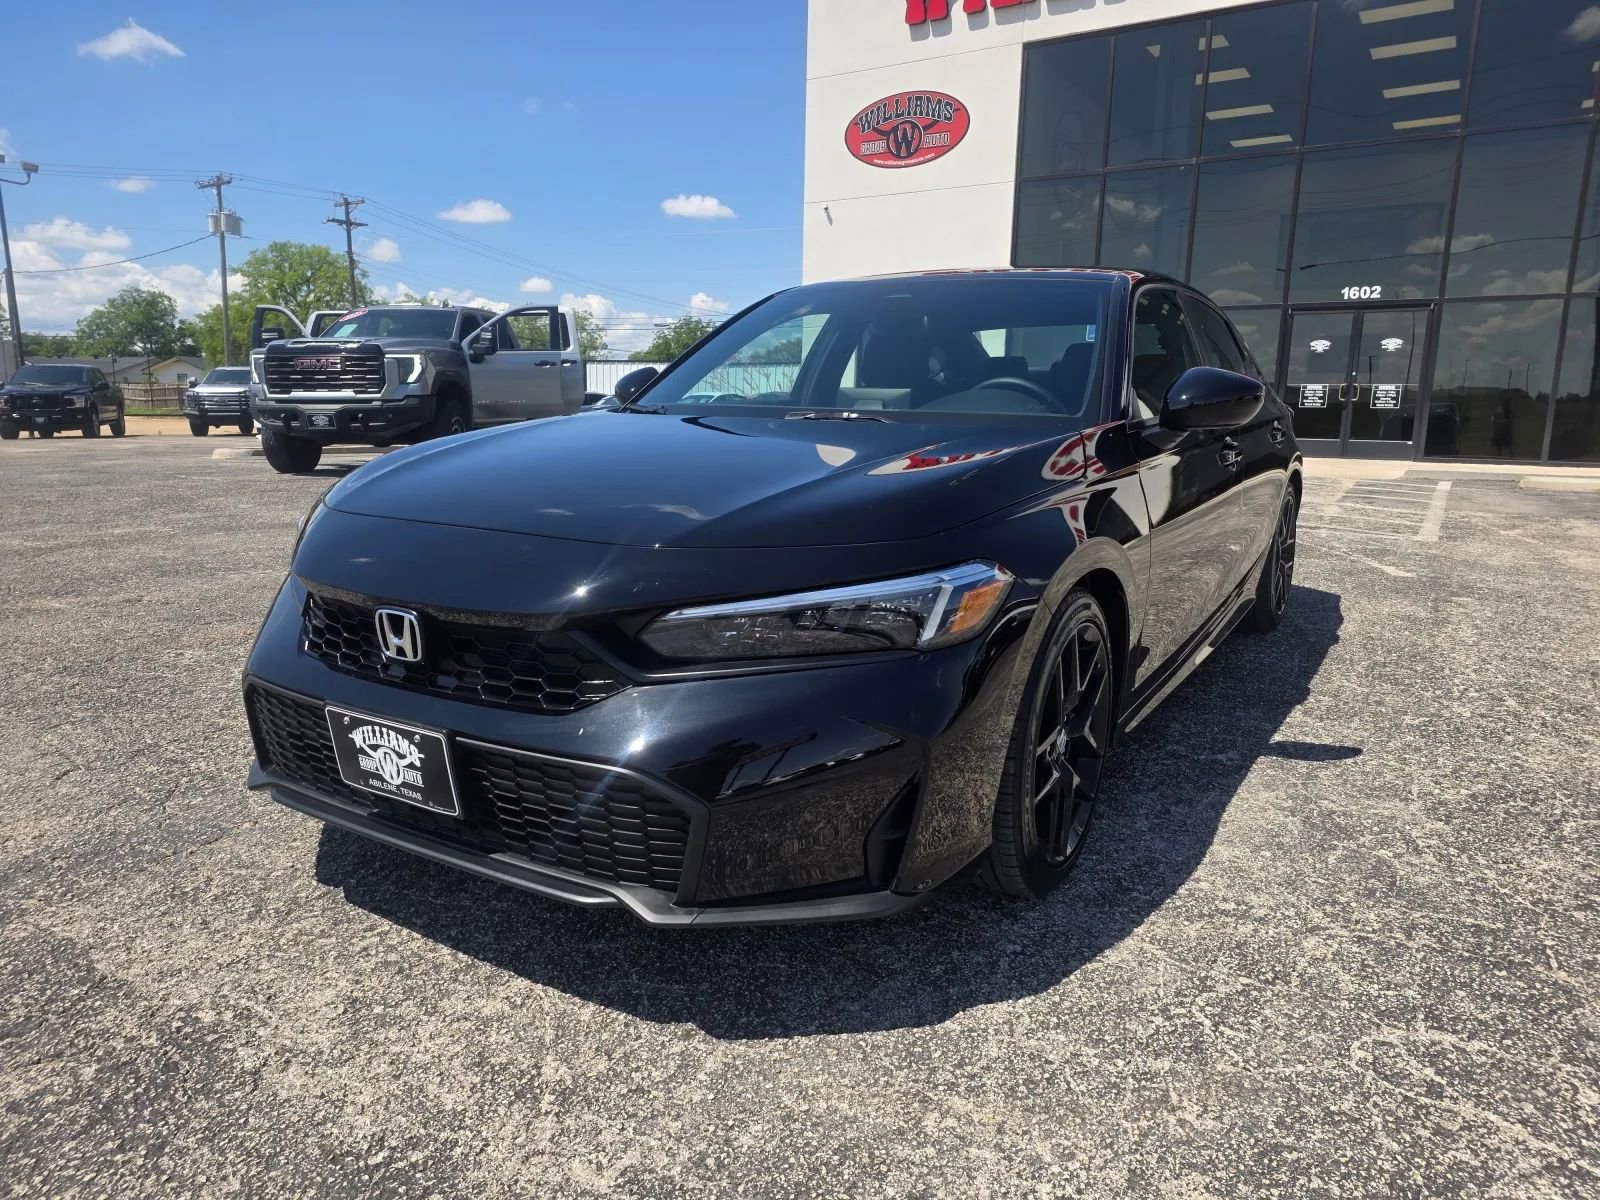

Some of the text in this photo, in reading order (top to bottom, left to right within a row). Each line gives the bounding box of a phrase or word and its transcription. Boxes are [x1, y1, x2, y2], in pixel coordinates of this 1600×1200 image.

[859, 95, 953, 135] WILLIAMS
[924, 133, 950, 147] AUTO
[861, 141, 887, 155] GROUP
[1341, 285, 1382, 300] 1602
[297, 358, 341, 370] GMC
[351, 725, 421, 768] WILLIAMS
[404, 769, 423, 785] AUTO
[369, 778, 422, 800] ABILENE, TEXAS
